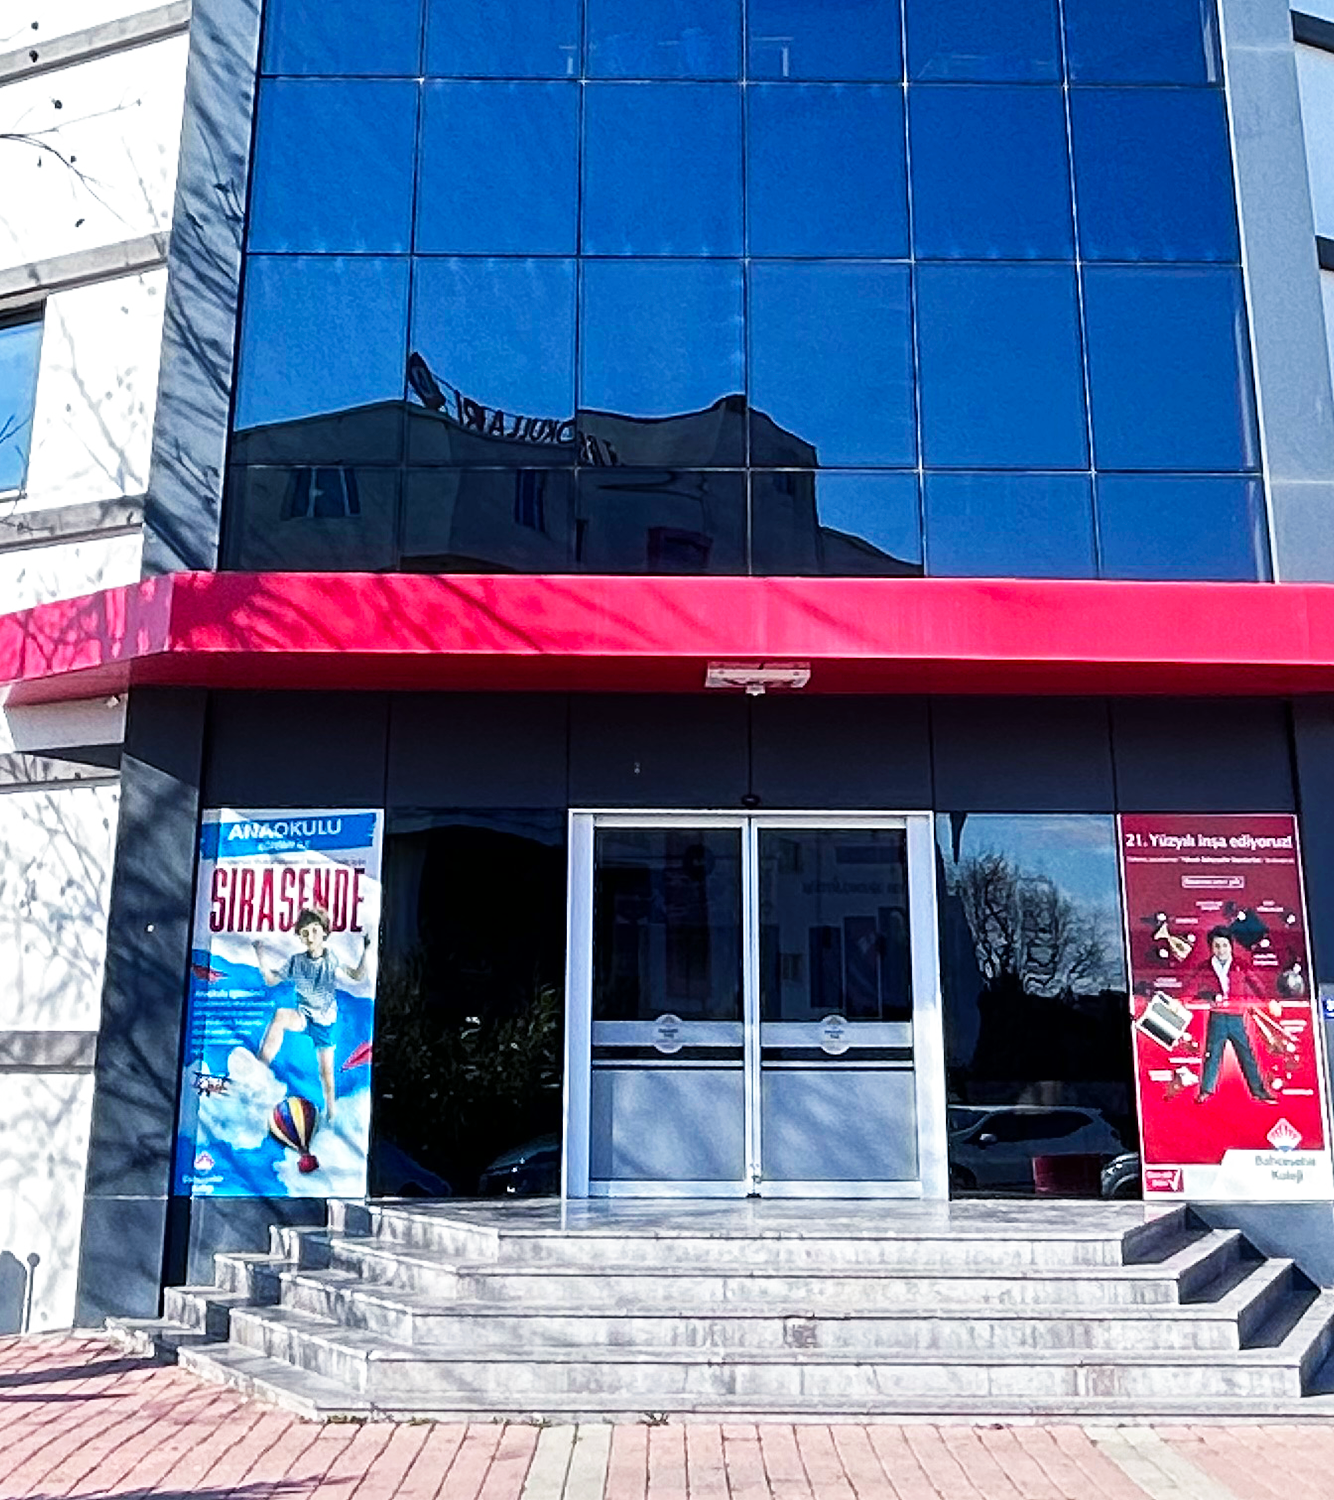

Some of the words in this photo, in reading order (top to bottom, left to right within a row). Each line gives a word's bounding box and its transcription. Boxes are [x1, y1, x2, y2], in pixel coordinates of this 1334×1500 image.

[227, 818, 342, 841] ANAOKULU
[1125, 833, 1149, 848] 21.
[1229, 834, 1293, 851] ediyoruz!
[209, 867, 366, 933] SIRASENDE
